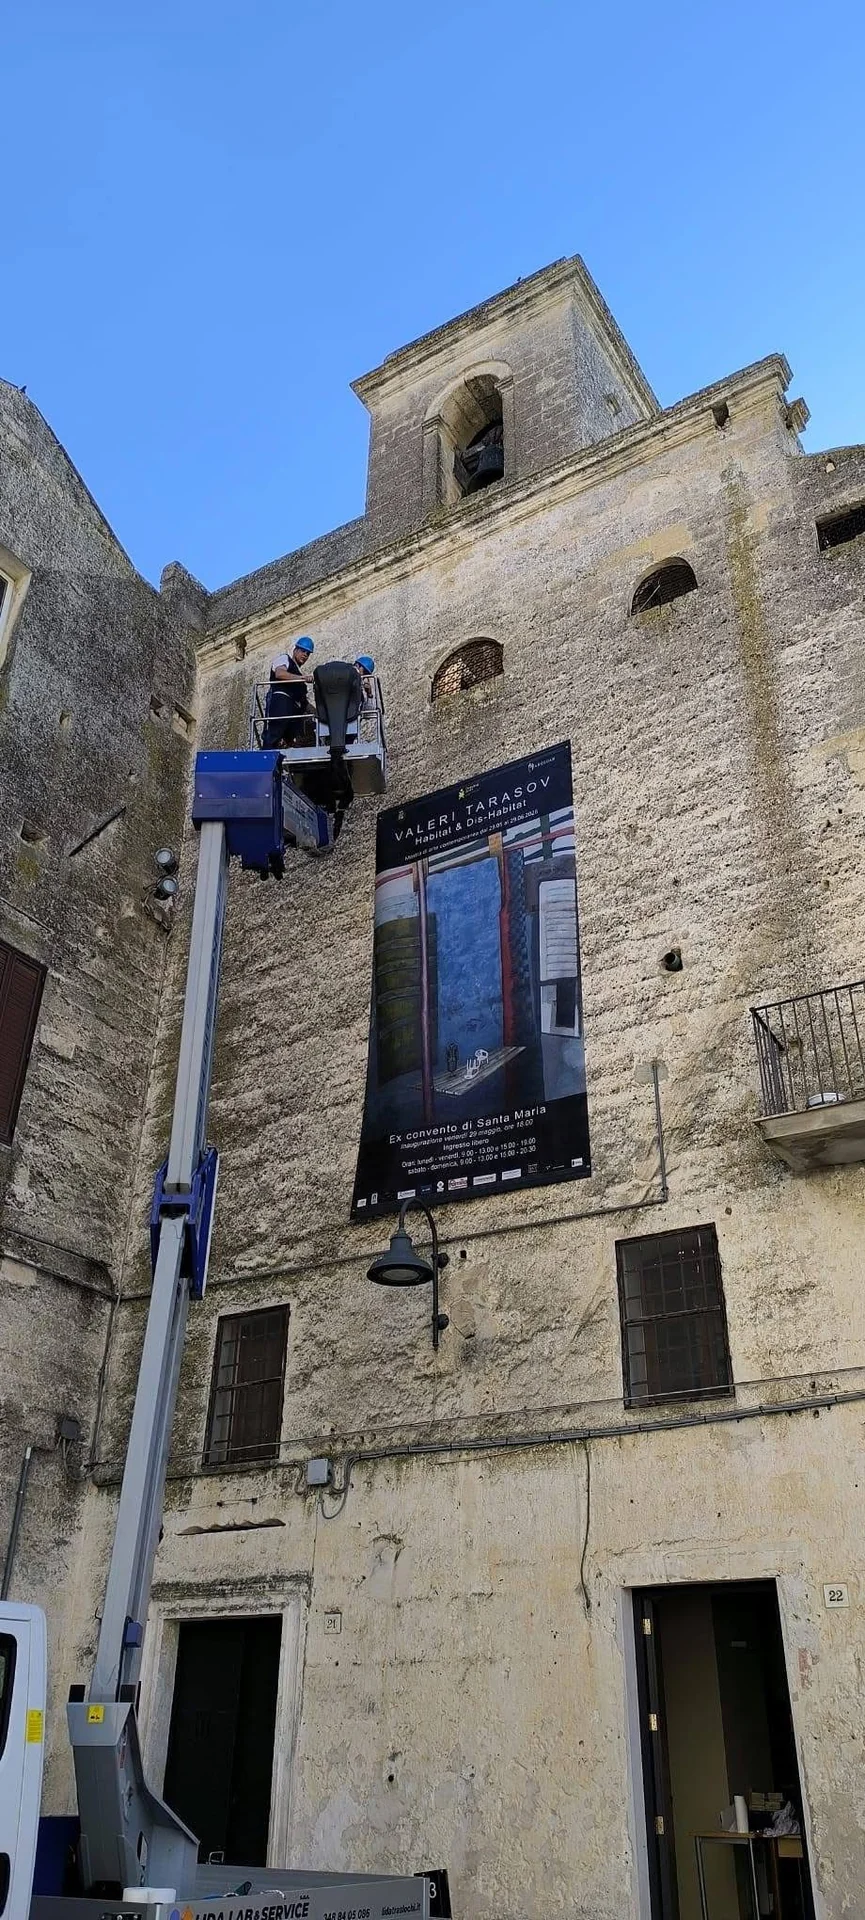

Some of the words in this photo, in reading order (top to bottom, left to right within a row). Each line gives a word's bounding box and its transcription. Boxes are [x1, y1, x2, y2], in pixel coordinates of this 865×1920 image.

[395, 811, 455, 842] VALERI
[466, 776, 550, 815] TARASOV
[415, 826, 452, 845] Habitat
[455, 822, 462, 831] &
[466, 799, 527, 827] Dis-Habitat
[389, 1134, 402, 1144] Ex
[406, 1124, 457, 1140] convento
[462, 1120, 472, 1130] di
[476, 1115, 510, 1128] Santa
[514, 1105, 547, 1120] Maria
[469, 1130, 477, 1138] 29
[443, 1141, 470, 1151] Ingresso
[471, 1138, 489, 1146] libero
[829, 1590, 844, 1602] 22
[327, 1619, 336, 1629] 21
